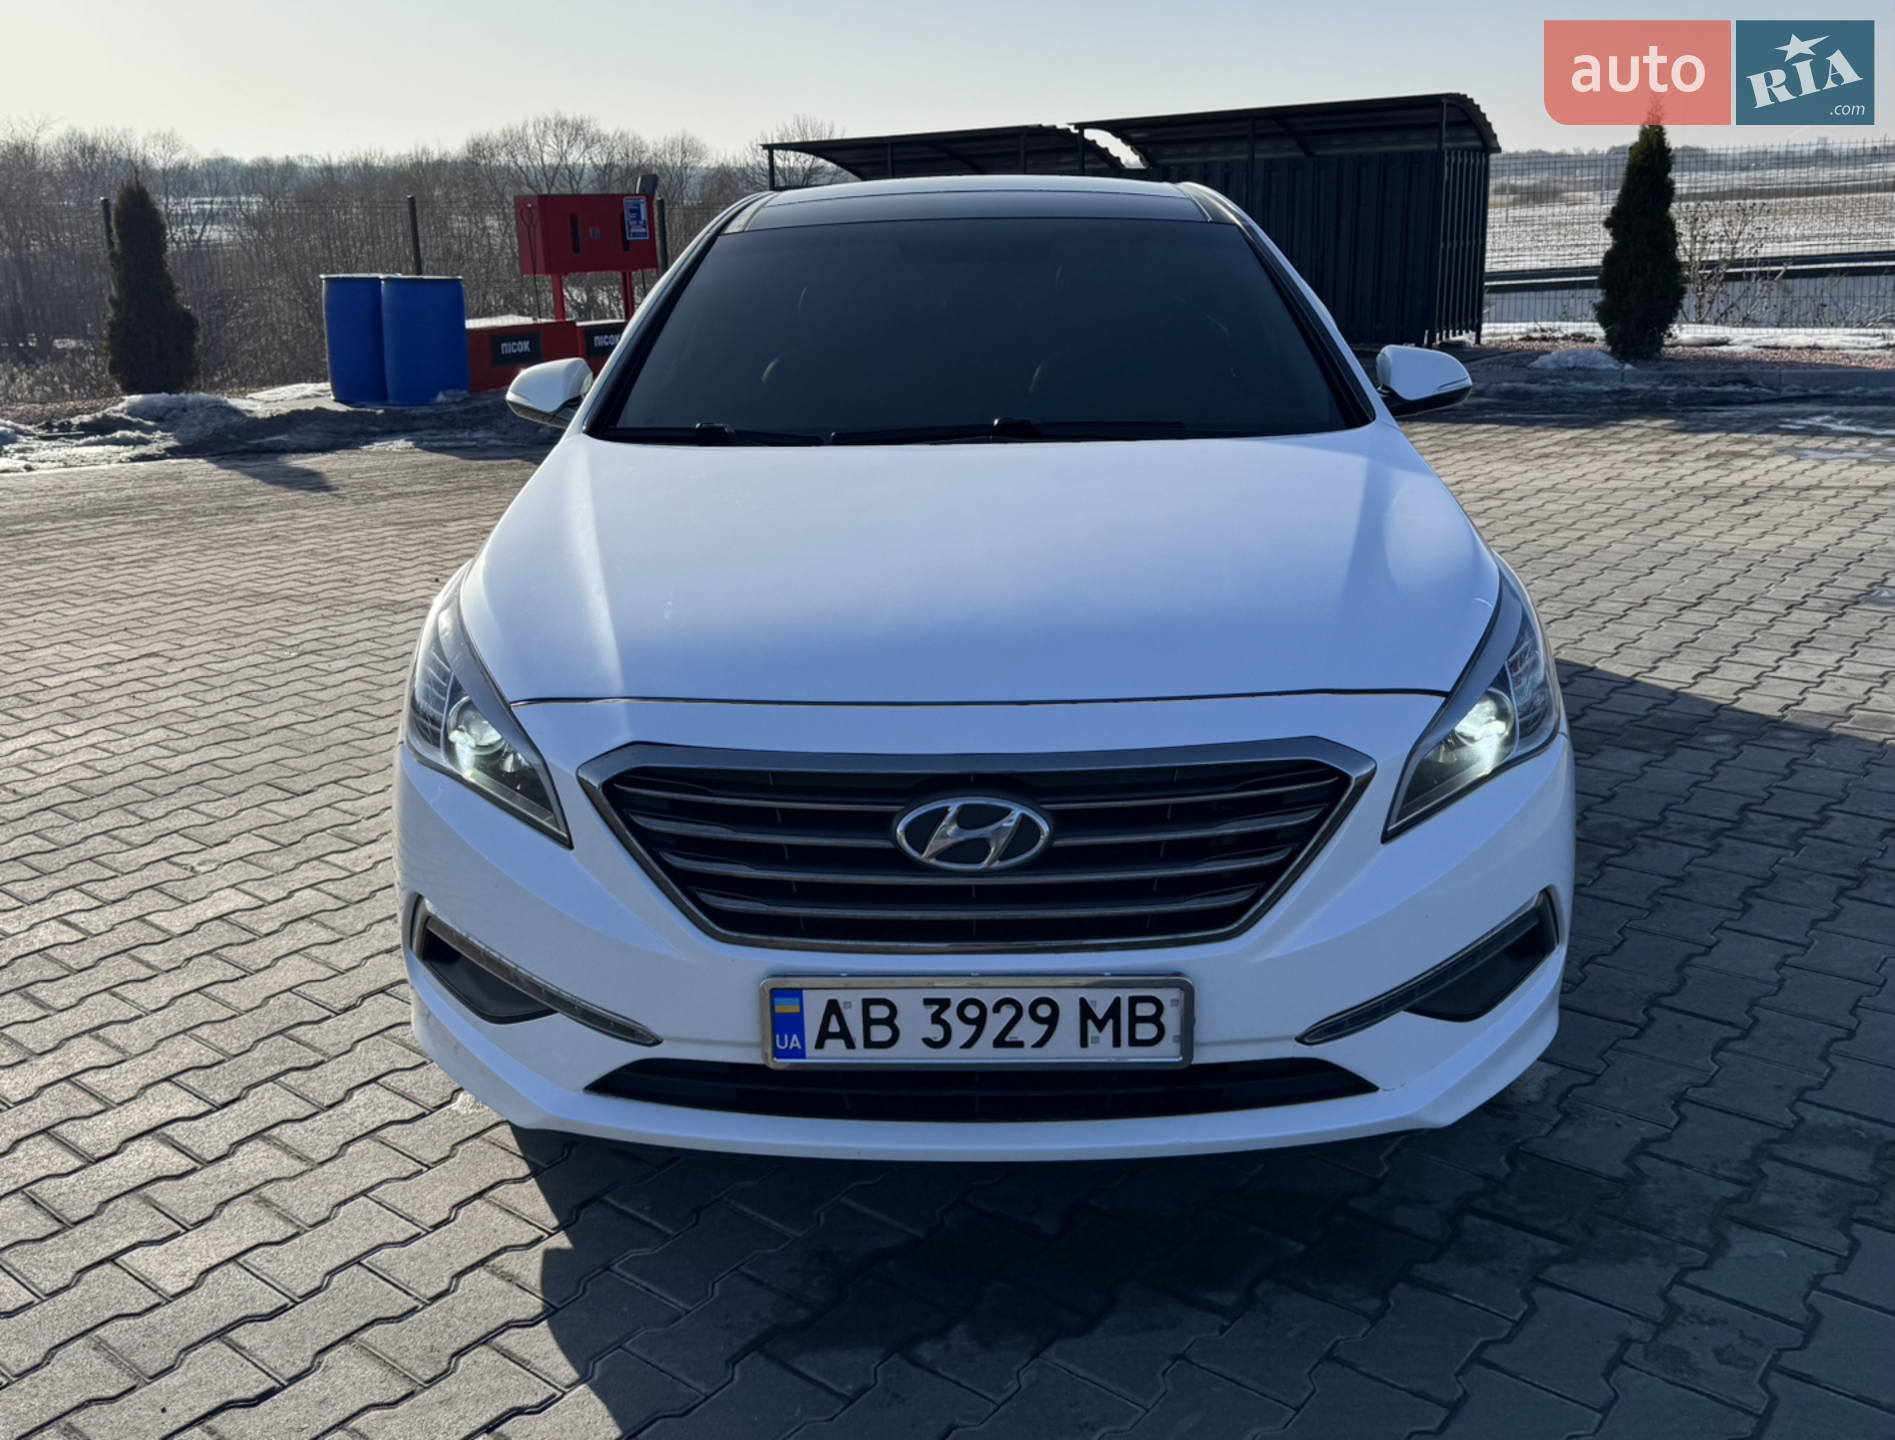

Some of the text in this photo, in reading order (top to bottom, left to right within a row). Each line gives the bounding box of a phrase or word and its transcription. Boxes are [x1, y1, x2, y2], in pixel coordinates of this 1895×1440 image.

[501, 340, 531, 354] ПІСОК
[814, 995, 1166, 1050] AB 3929 MB
[775, 1033, 802, 1050] UA
